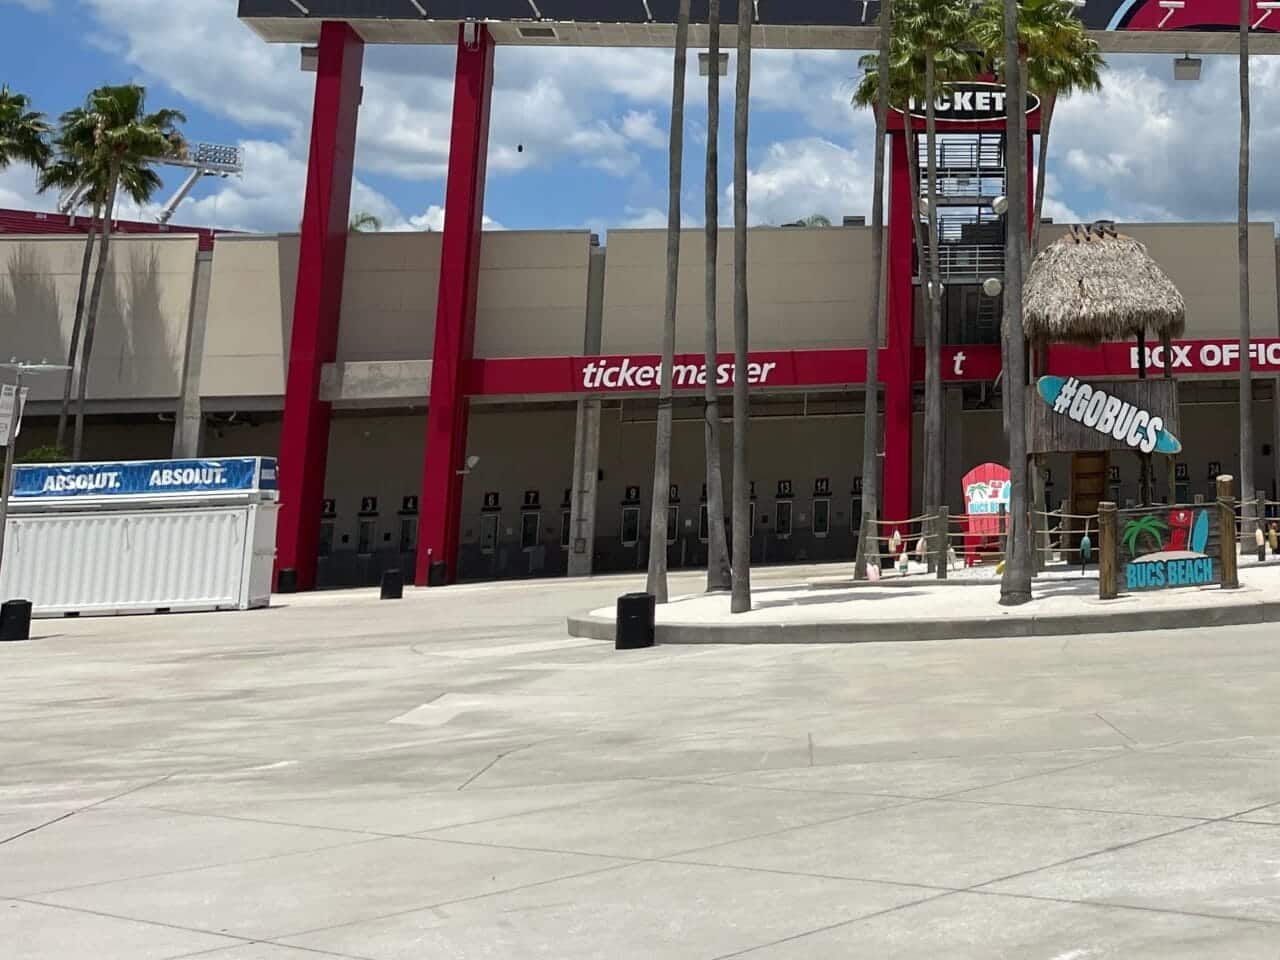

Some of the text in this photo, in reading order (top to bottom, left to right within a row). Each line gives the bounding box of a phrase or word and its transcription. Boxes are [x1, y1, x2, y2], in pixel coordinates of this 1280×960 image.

[953, 351, 966, 375] t
[1130, 344, 1192, 369] BOX
[1053, 376, 1163, 454] #GOBUCS
[1126, 557, 1213, 588] BUCS BEACH
